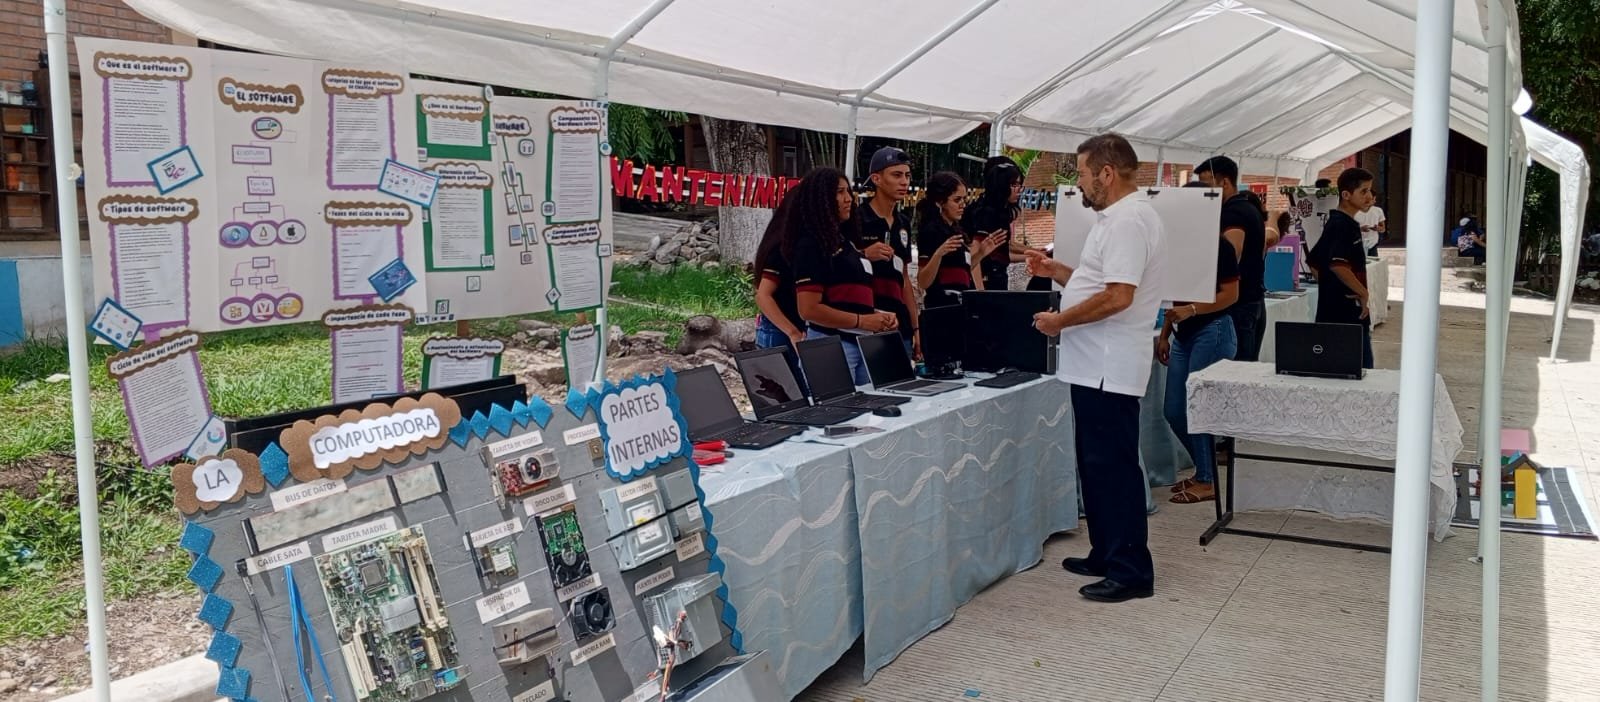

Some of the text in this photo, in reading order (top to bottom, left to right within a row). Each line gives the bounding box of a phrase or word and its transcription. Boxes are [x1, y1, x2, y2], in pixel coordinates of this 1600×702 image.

[236, 91, 246, 100] EL
[609, 155, 801, 209] MANTENIMI
[110, 205, 132, 214] Tipos
[146, 205, 186, 213] software
[609, 392, 660, 424] PARTES
[313, 413, 438, 456] COMPUTADORA
[610, 425, 679, 465] INTERNAS
[203, 468, 230, 491] LA
[285, 481, 337, 503] BUS DE DATOS
[534, 496, 550, 508] DISCO
[332, 522, 388, 545] TARJETA MADRE
[257, 547, 304, 568] CABLE SATA
